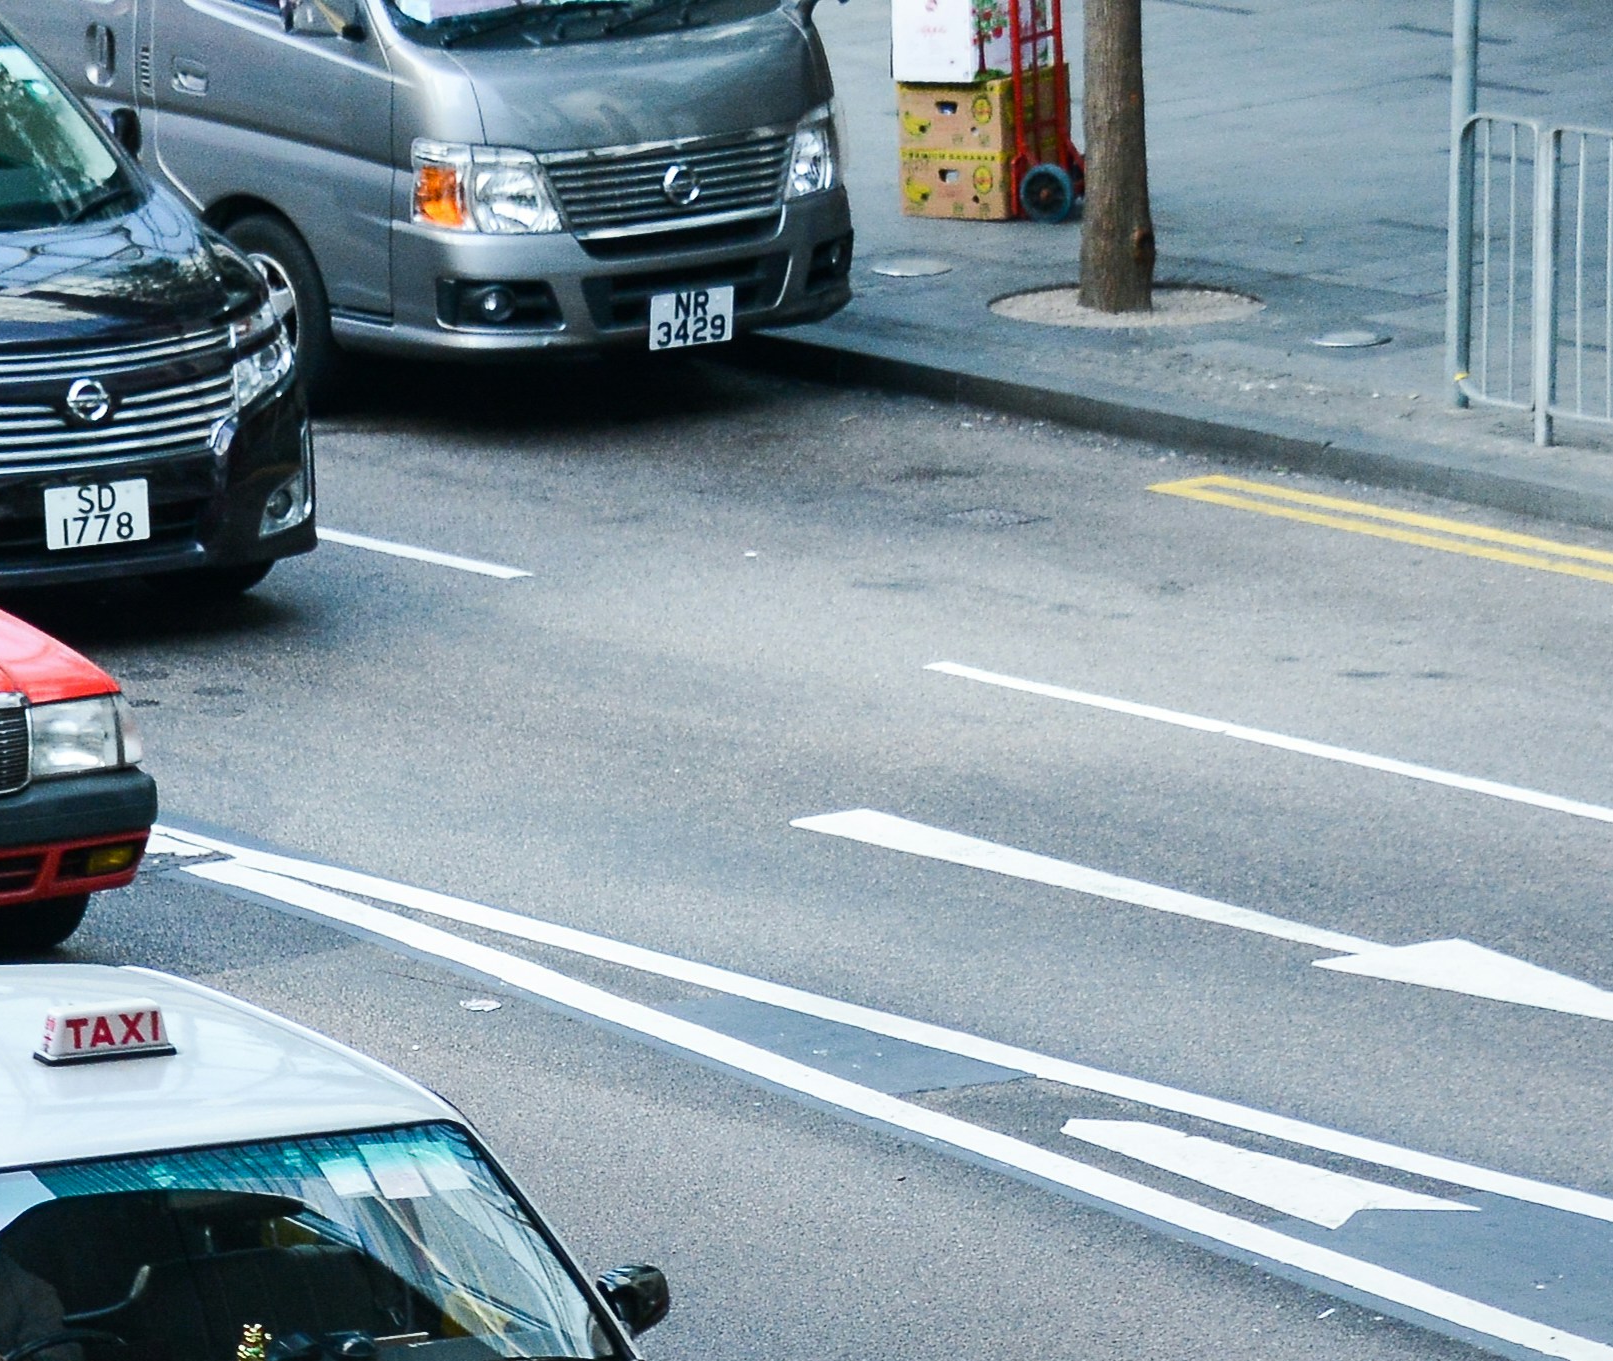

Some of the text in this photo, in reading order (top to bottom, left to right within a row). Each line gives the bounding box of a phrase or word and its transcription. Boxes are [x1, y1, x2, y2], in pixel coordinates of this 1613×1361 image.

[675, 291, 709, 319] NR
[657, 314, 726, 347] 3429
[78, 485, 116, 514] SD
[63, 512, 134, 546] 1778
[65, 1010, 160, 1049] TAXI
